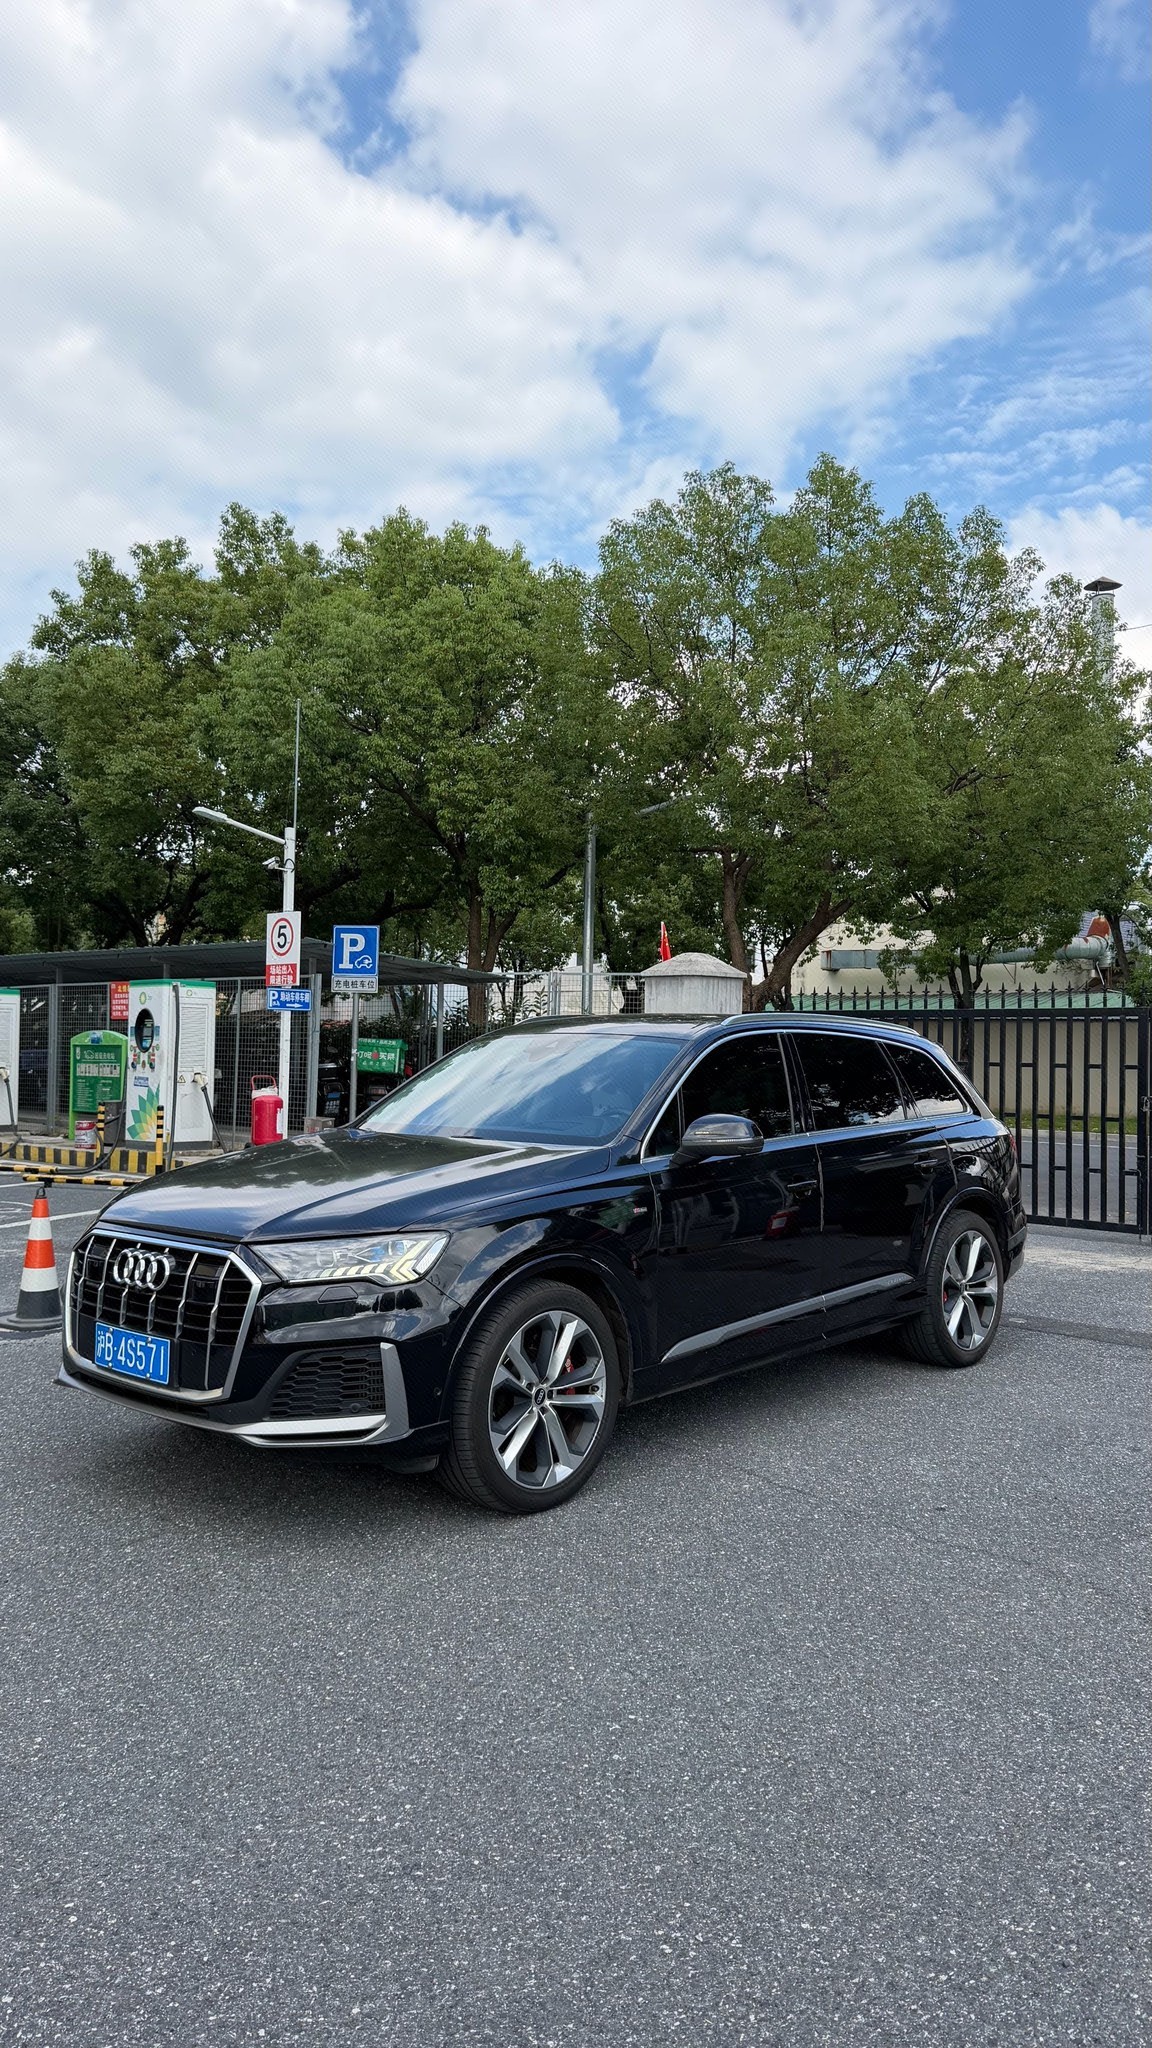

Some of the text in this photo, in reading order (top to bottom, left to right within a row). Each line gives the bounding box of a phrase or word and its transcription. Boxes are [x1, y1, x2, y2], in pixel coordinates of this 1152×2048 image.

[277, 924, 287, 949] 5
[338, 933, 365, 969] P
[334, 979, 375, 989] 充电桩车位
[269, 990, 279, 1007] P
